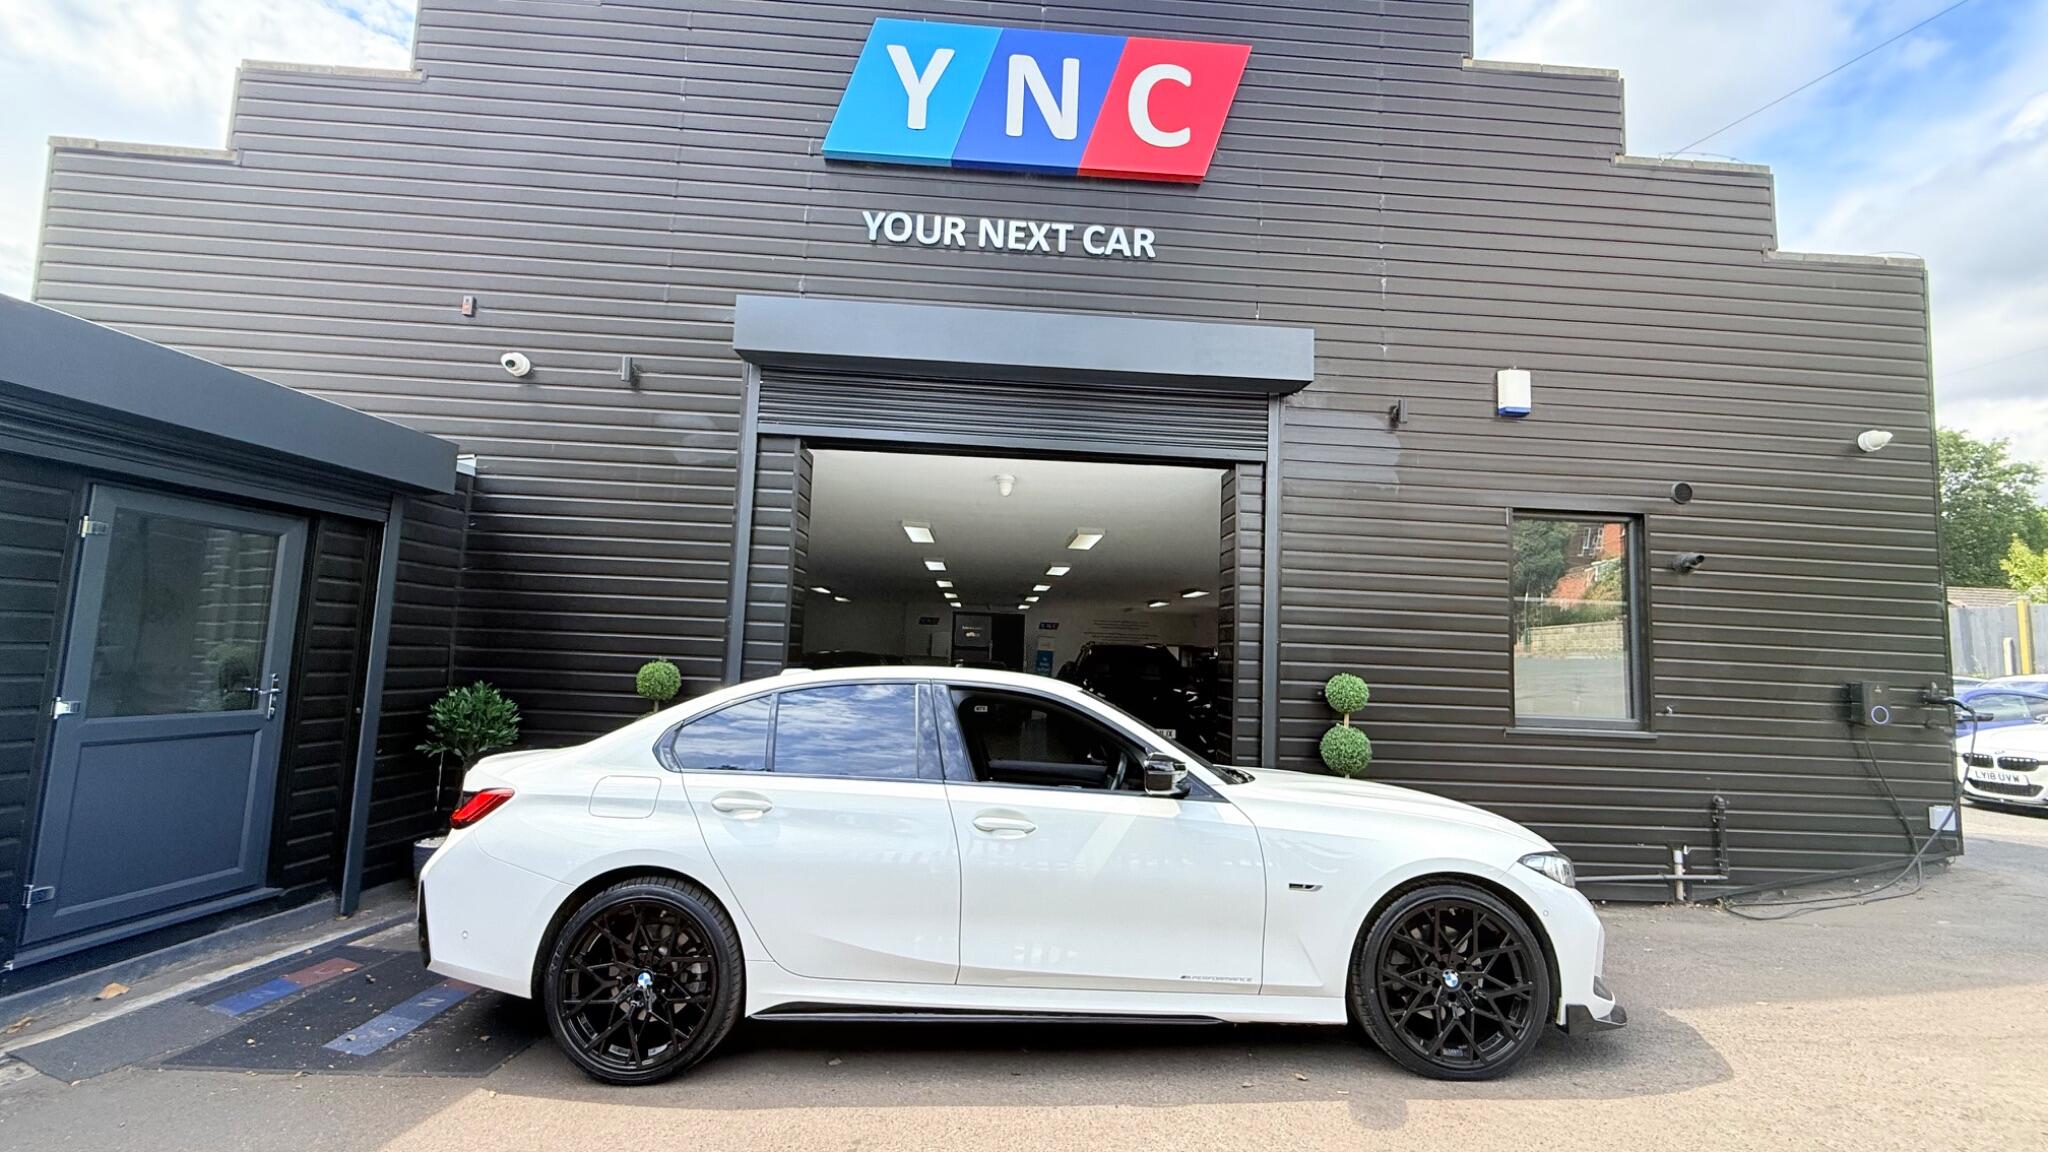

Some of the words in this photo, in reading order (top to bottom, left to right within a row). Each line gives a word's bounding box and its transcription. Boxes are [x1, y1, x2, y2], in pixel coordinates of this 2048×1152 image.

[886, 44, 1193, 148] YNC
[862, 210, 967, 248] YOUR
[977, 217, 1075, 253] NEXT
[1082, 225, 1157, 259] CAR
[1975, 770, 1997, 781] LY18
[1998, 773, 2020, 783] UVW
